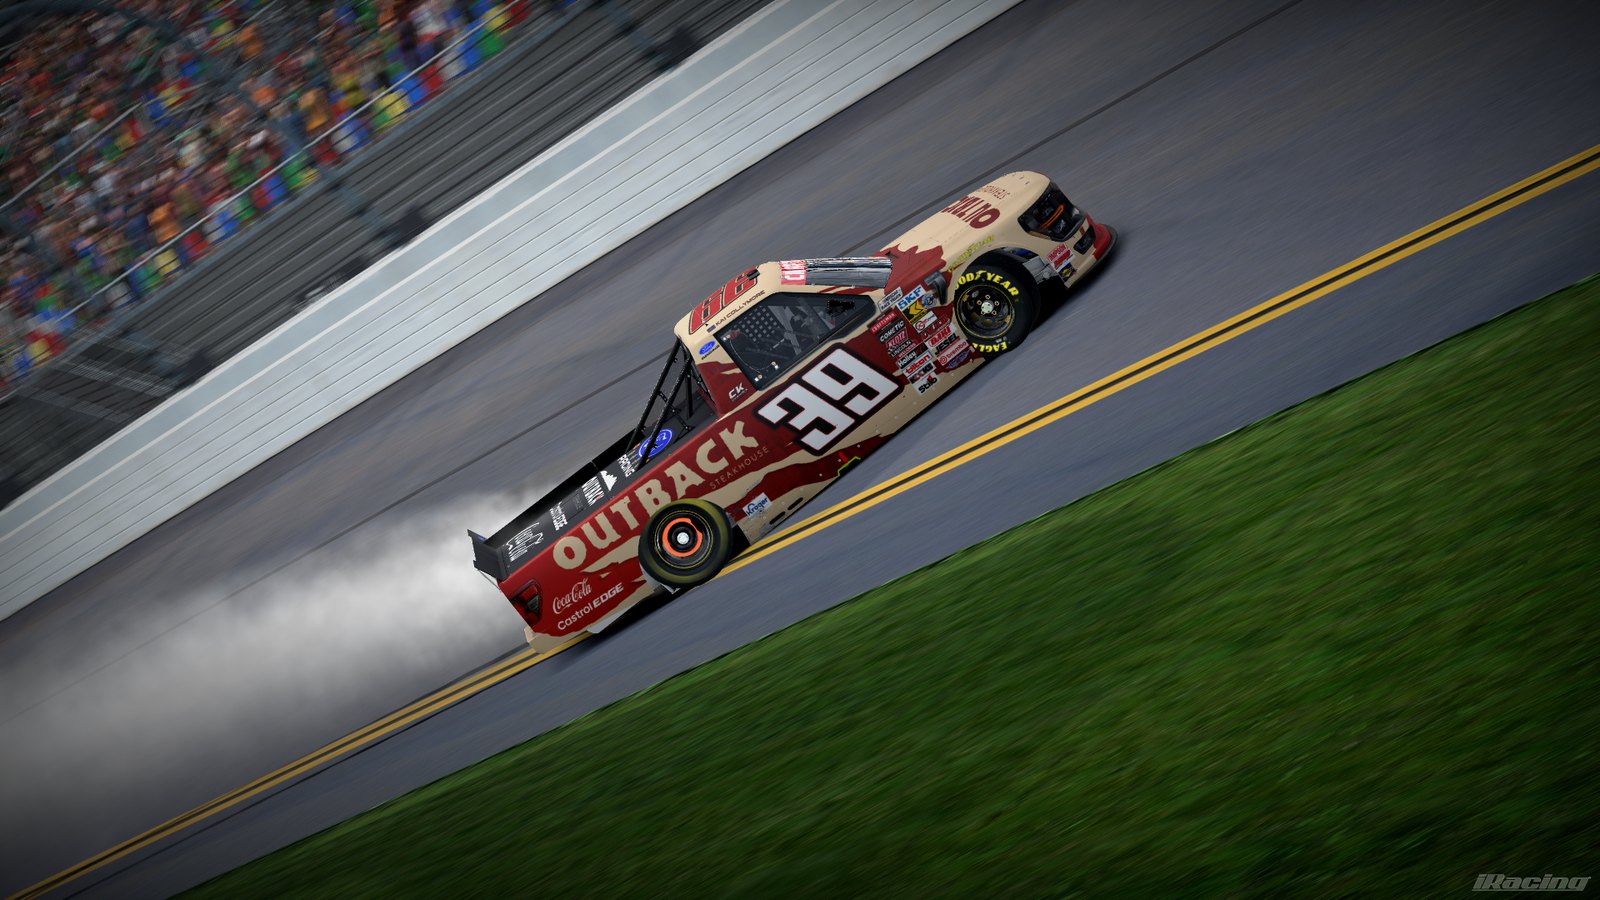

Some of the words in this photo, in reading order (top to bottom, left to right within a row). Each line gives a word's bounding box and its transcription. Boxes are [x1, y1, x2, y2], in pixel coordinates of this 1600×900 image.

[716, 317, 727, 326] KAI
[726, 290, 766, 318] COLLYMORE
[898, 286, 922, 309] SKF
[880, 320, 905, 342] COMETIC
[891, 340, 912, 357] LINCOLN
[934, 333, 959, 355] JESEL
[946, 341, 968, 358] brembo
[898, 350, 917, 368] Holley
[905, 354, 930, 375] tilton
[728, 383, 744, 400] CK
[918, 374, 938, 394] Stilo
[757, 347, 900, 451] 39
[709, 446, 769, 490] STEAKHOUSE
[552, 420, 760, 570] OUTBACK
[746, 497, 768, 516] Kroger
[552, 577, 592, 615] Coca-Cola
[557, 602, 593, 631] Castrol
[592, 582, 624, 609] EDGE
